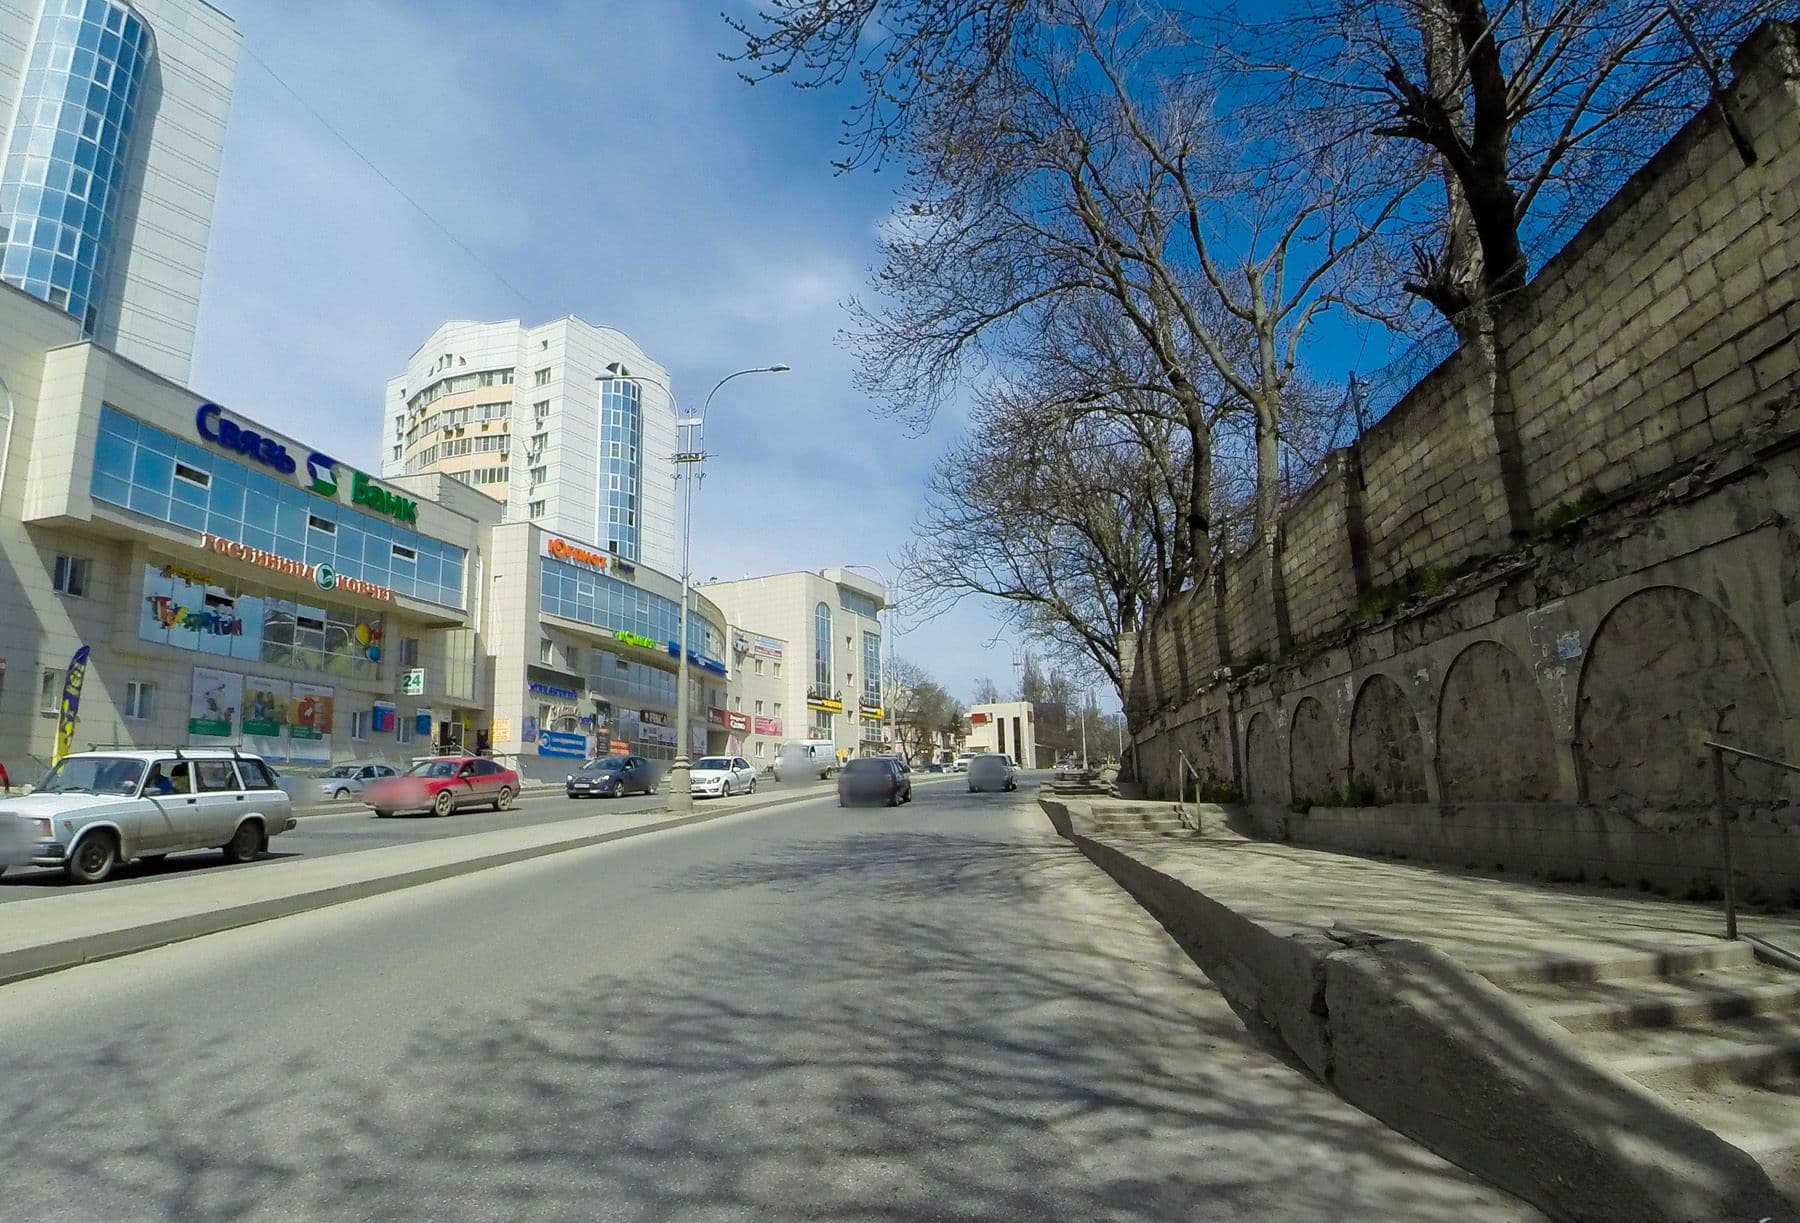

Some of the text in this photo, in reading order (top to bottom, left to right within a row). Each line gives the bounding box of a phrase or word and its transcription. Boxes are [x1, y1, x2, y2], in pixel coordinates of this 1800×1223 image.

[196, 403, 417, 524] Связь Банк
[403, 674, 421, 688] 24
